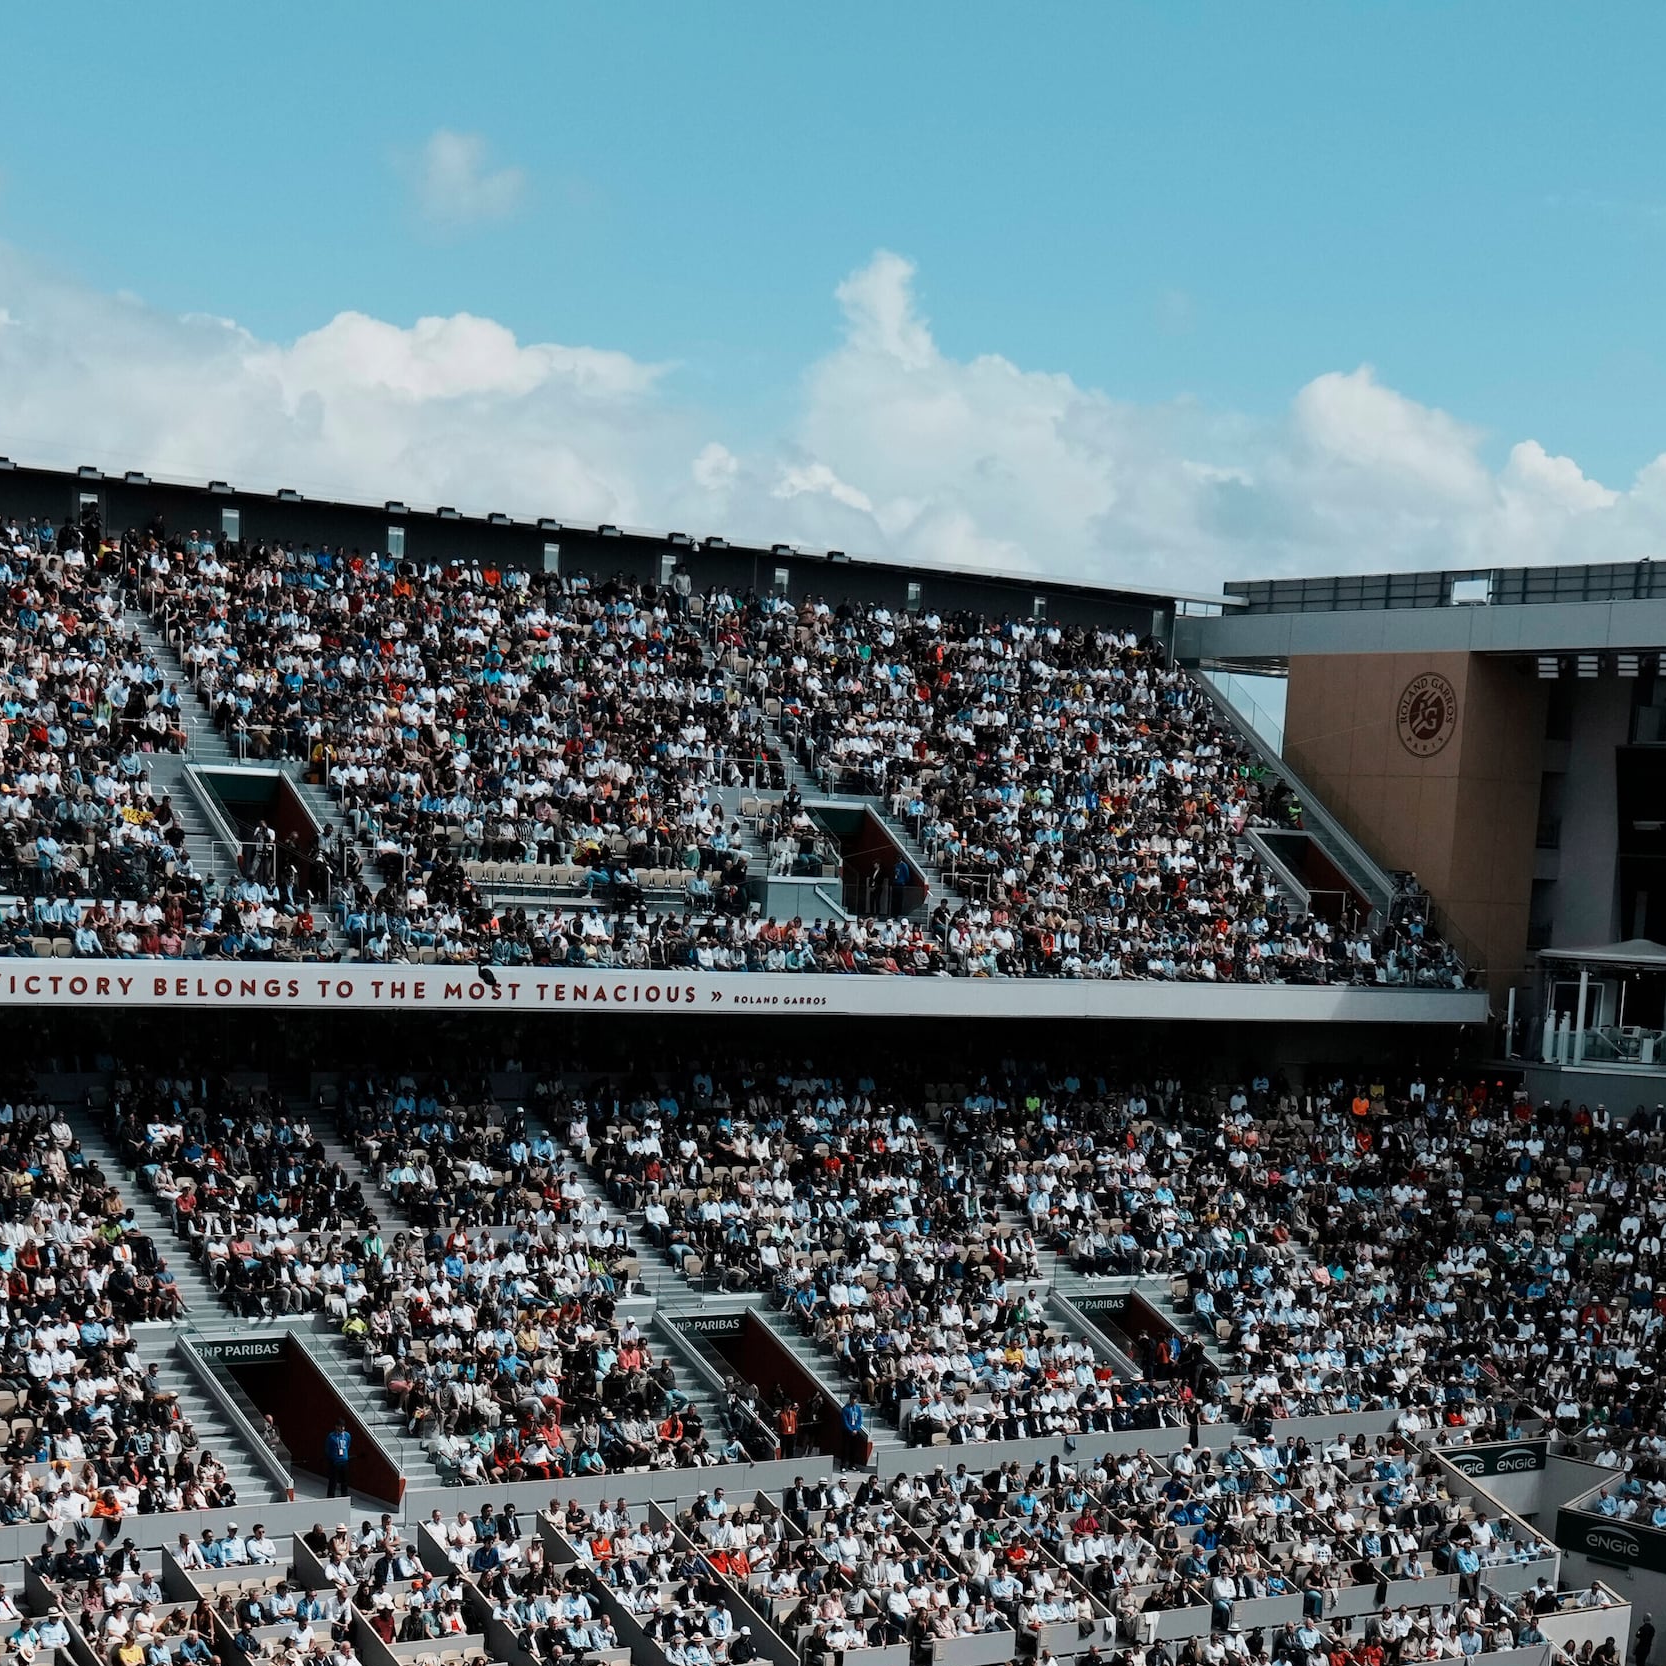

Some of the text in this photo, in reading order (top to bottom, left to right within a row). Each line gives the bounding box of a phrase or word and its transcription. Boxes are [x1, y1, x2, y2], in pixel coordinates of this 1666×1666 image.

[1400, 678, 1455, 724] ROLAND GARROS
[153, 977, 300, 998] BELONGS
[317, 979, 354, 999] TO
[371, 980, 426, 1000] THE
[444, 982, 521, 1001] MOST
[536, 984, 697, 1003] TENACIOUS
[734, 995, 828, 1006] ROLAND GARROS
[1085, 1299, 1125, 1310] PARIBAS
[694, 1318, 740, 1331] PARIBAS
[224, 1343, 280, 1357] PARIBAS
